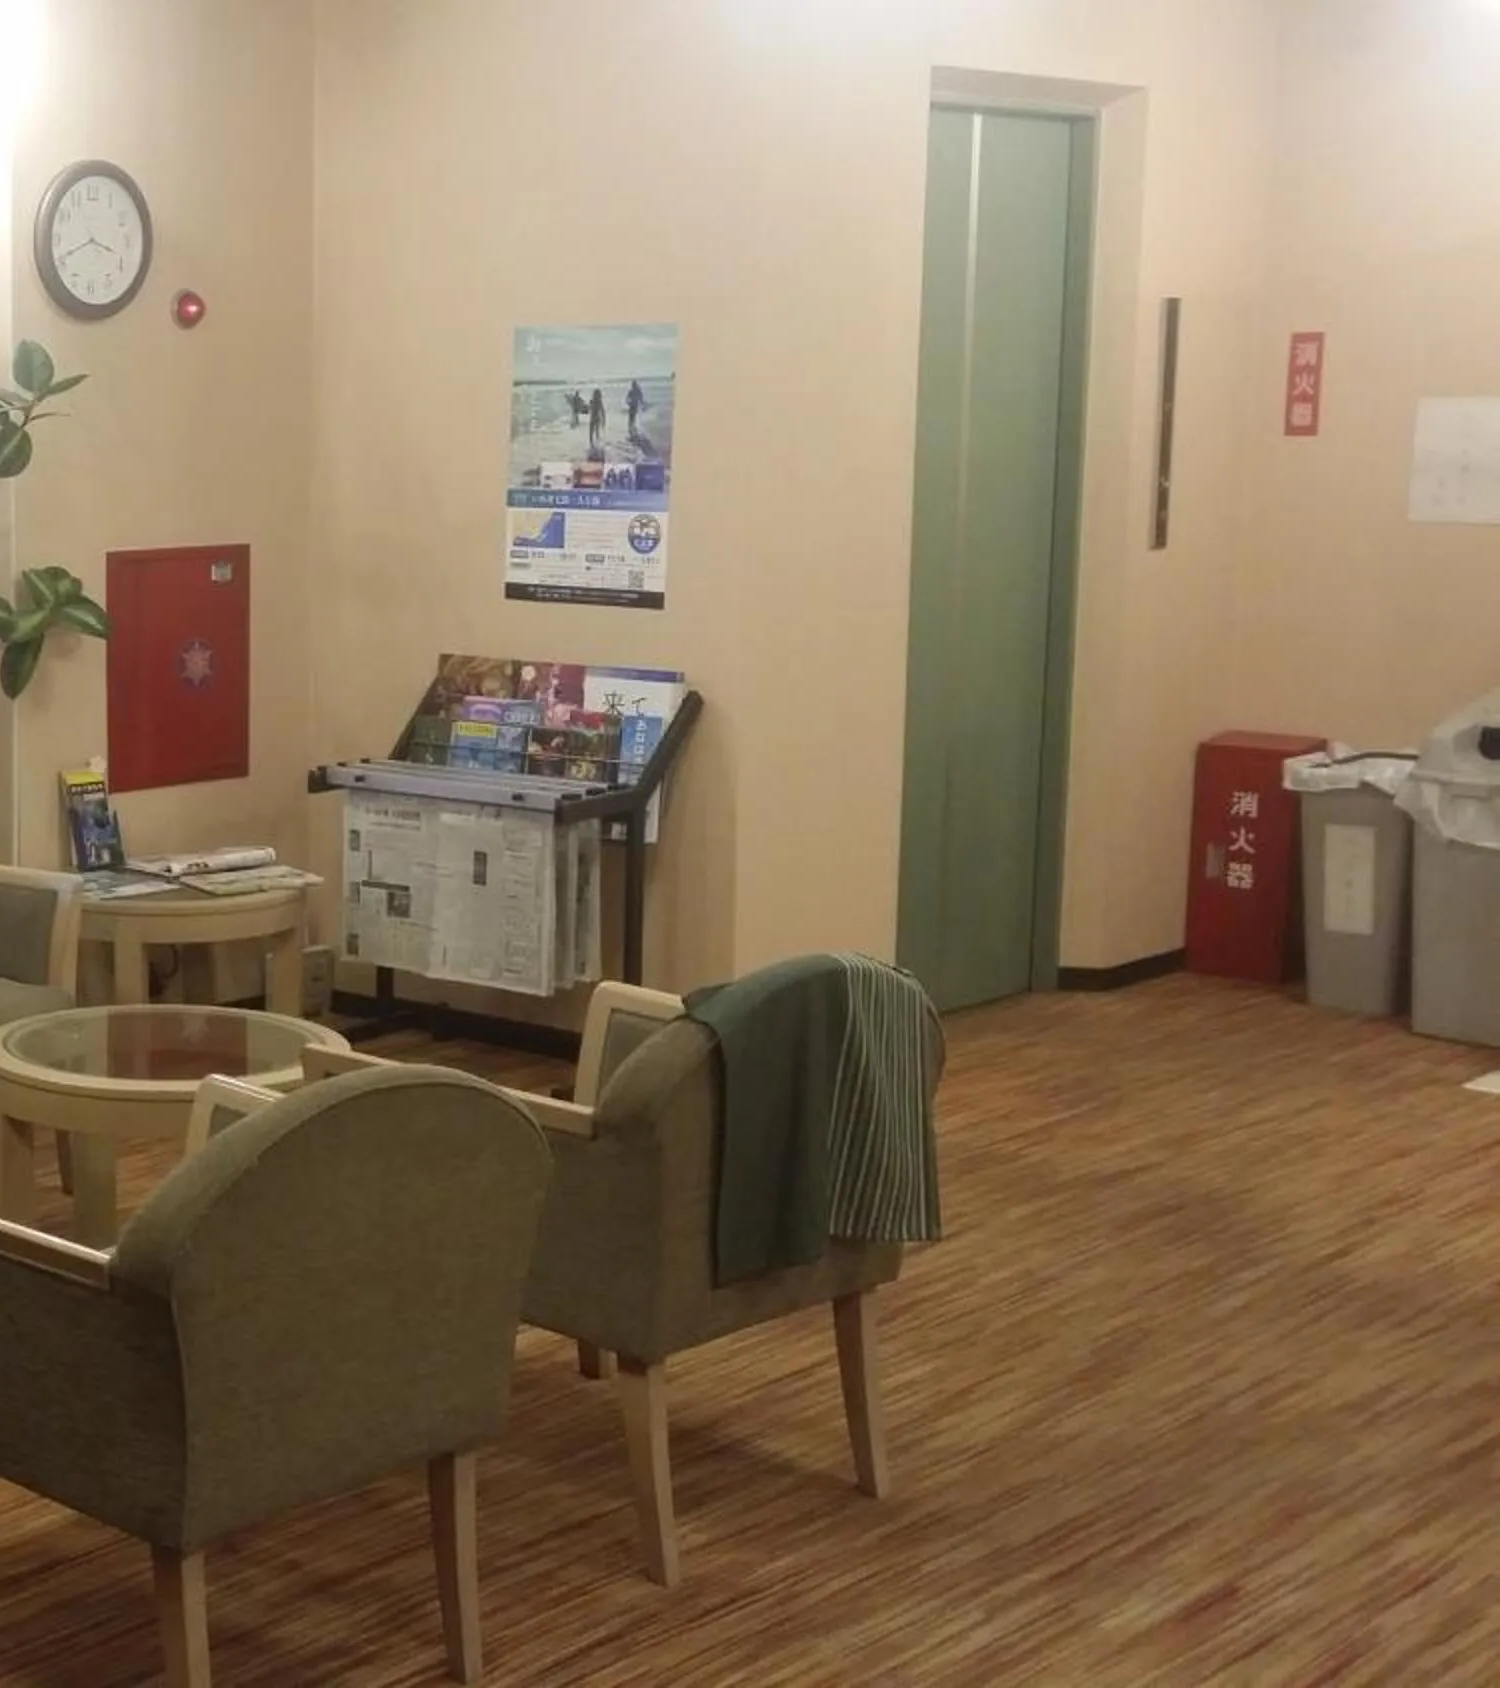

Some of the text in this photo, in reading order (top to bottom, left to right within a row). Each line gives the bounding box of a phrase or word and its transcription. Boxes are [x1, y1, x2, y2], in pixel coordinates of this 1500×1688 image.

[1291, 341, 1320, 427] 消火器
[1226, 791, 1260, 890] 消火器
